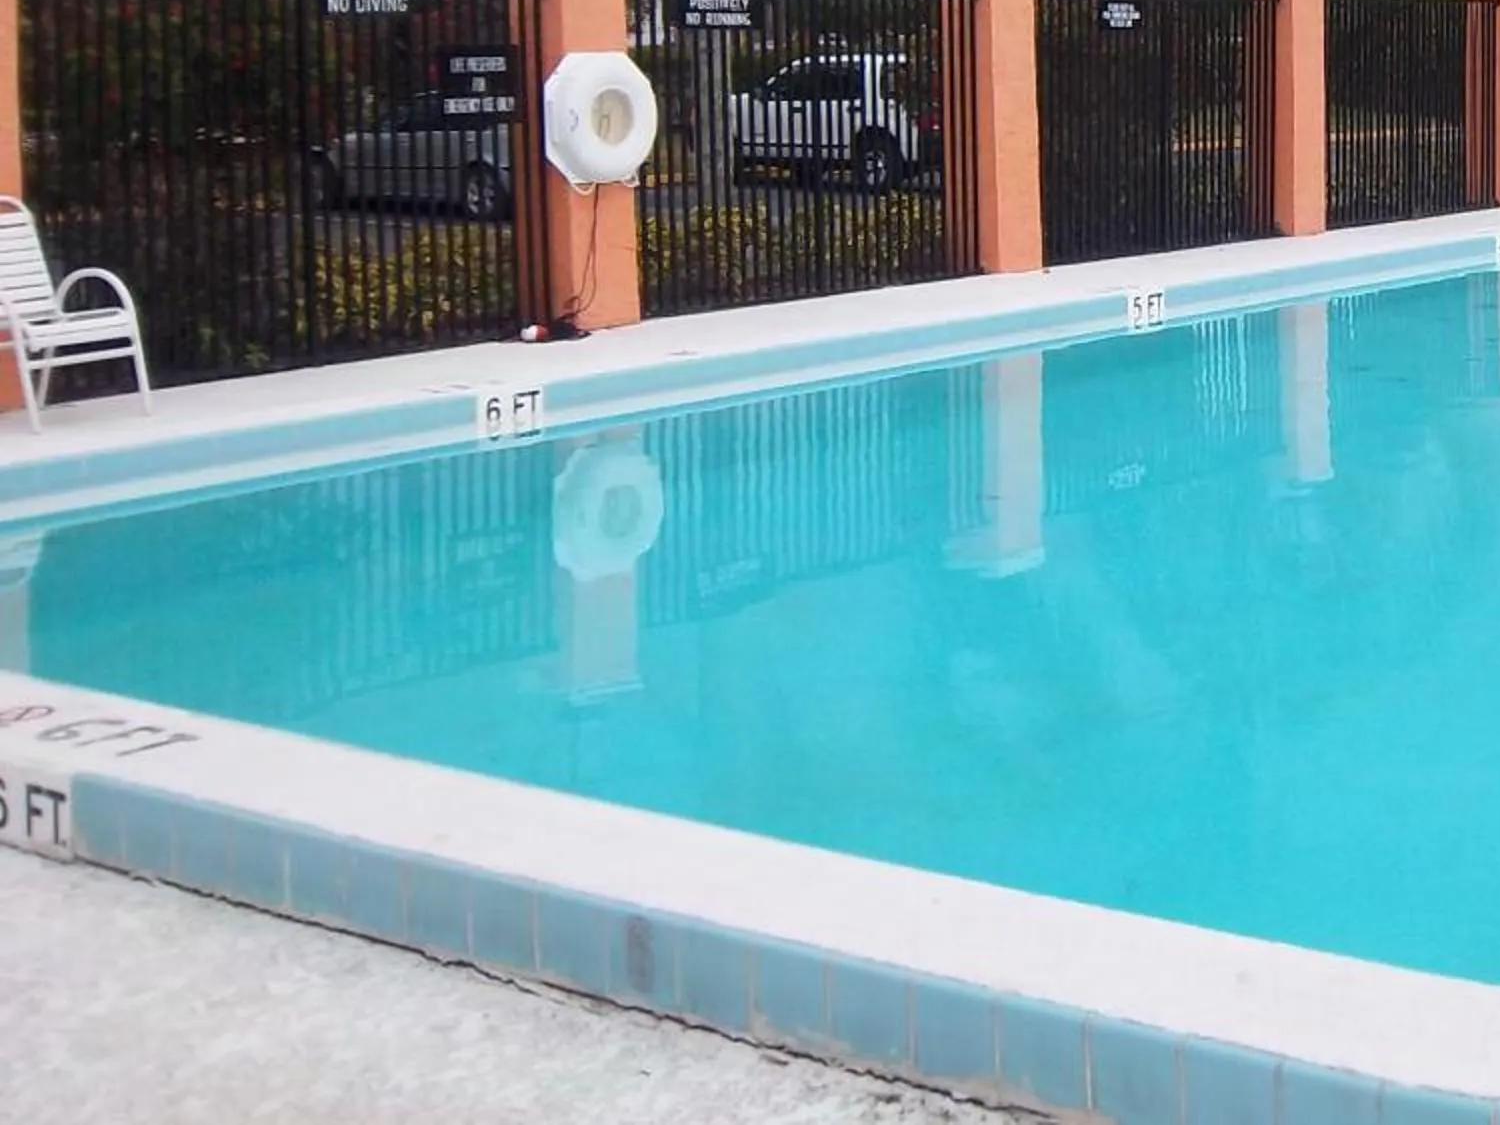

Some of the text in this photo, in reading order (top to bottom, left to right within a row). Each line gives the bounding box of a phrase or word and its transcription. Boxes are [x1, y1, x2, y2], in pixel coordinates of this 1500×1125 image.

[685, 12, 700, 25] NO
[1147, 292, 1163, 315] FT
[486, 390, 541, 422] 6 FT
